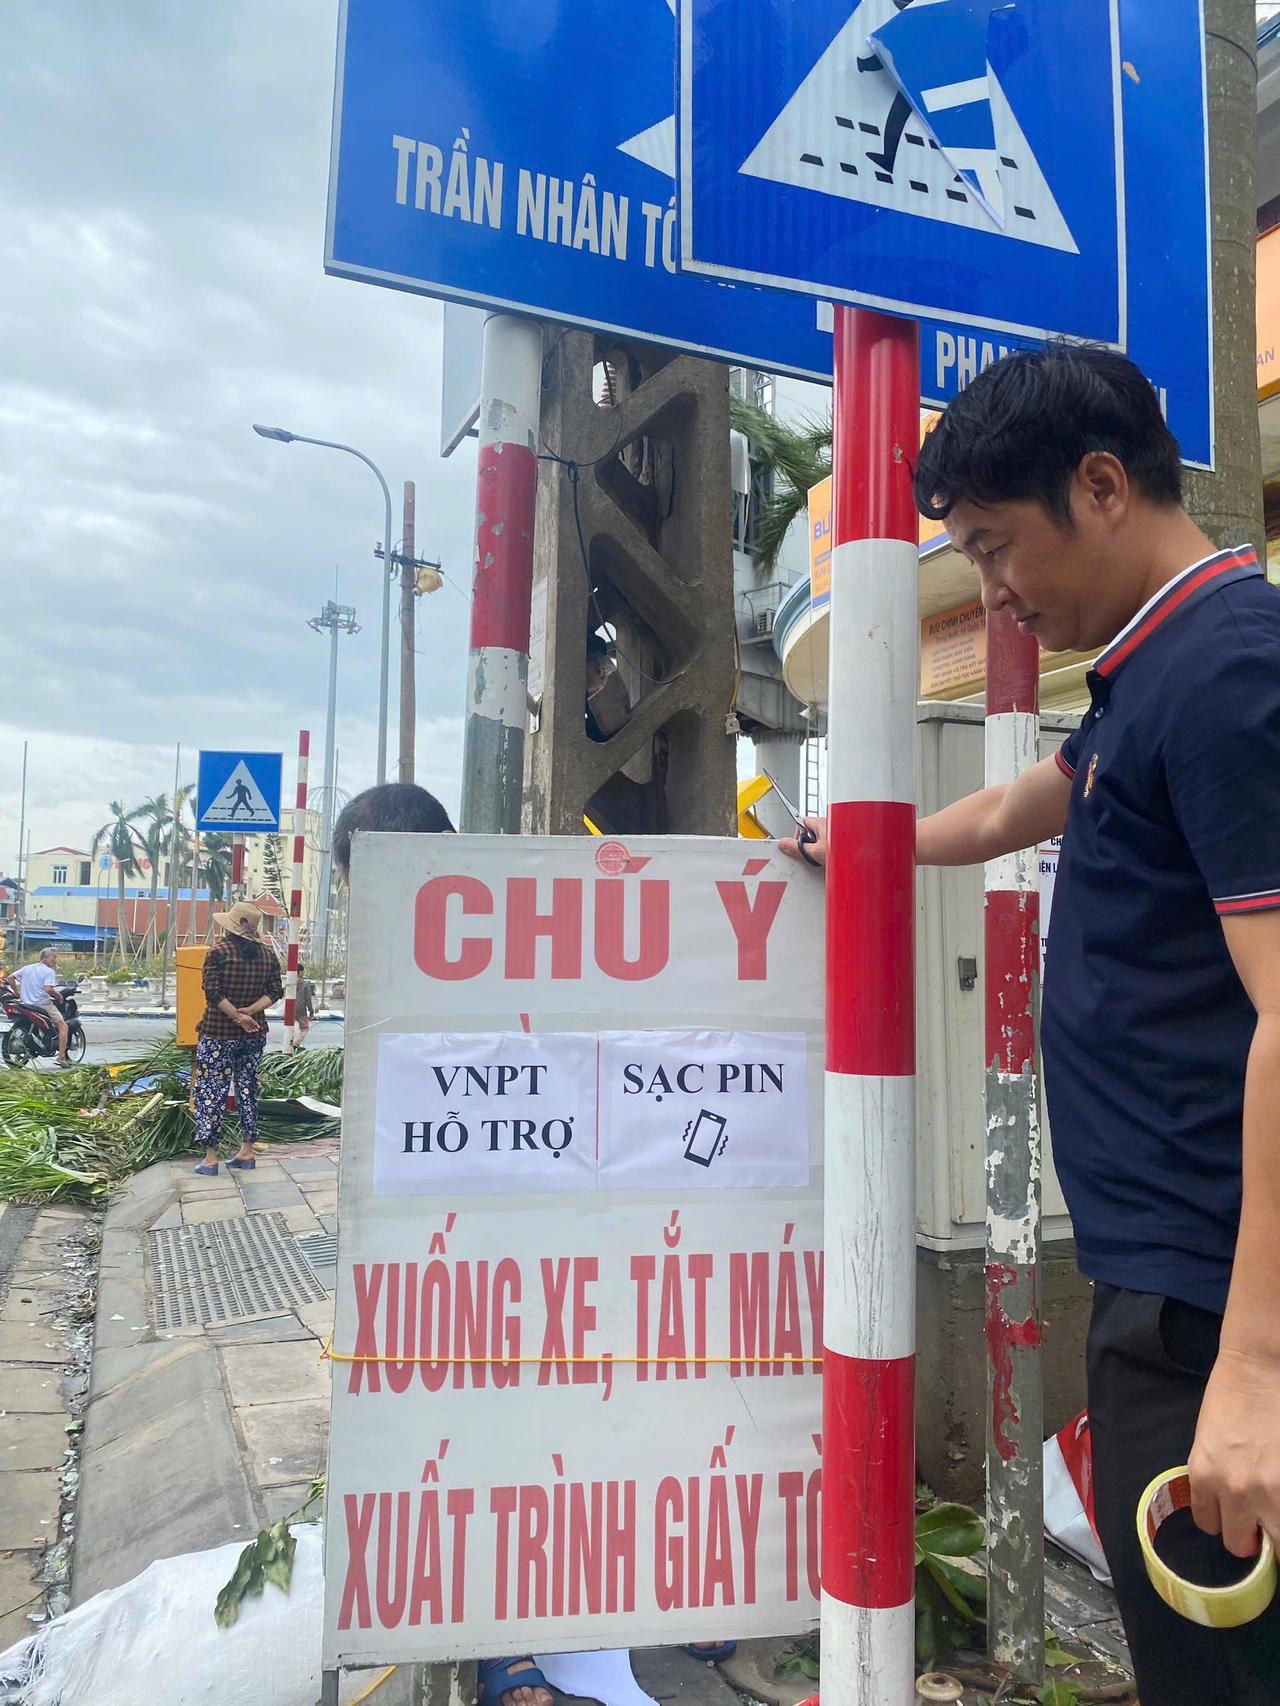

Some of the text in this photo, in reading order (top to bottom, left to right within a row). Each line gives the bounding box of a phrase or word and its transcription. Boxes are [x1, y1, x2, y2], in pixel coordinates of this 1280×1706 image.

[392, 127, 503, 229] TRẦN
[516, 173, 628, 261] NHÂN
[414, 856, 787, 981] CHÚ Ý
[401, 1111, 574, 1159] HỖ TRỢ
[432, 1065, 547, 1098] VNPT
[623, 1063, 785, 1102] SẠC PIN
[347, 1212, 522, 1394] XUỐNG
[537, 1256, 613, 1401] XE,
[630, 1209, 714, 1382] TẮT
[337, 1438, 474, 1630] XUẤT
[490, 1454, 636, 1621] TRÌNH
[654, 1425, 764, 1612] GIẤY
